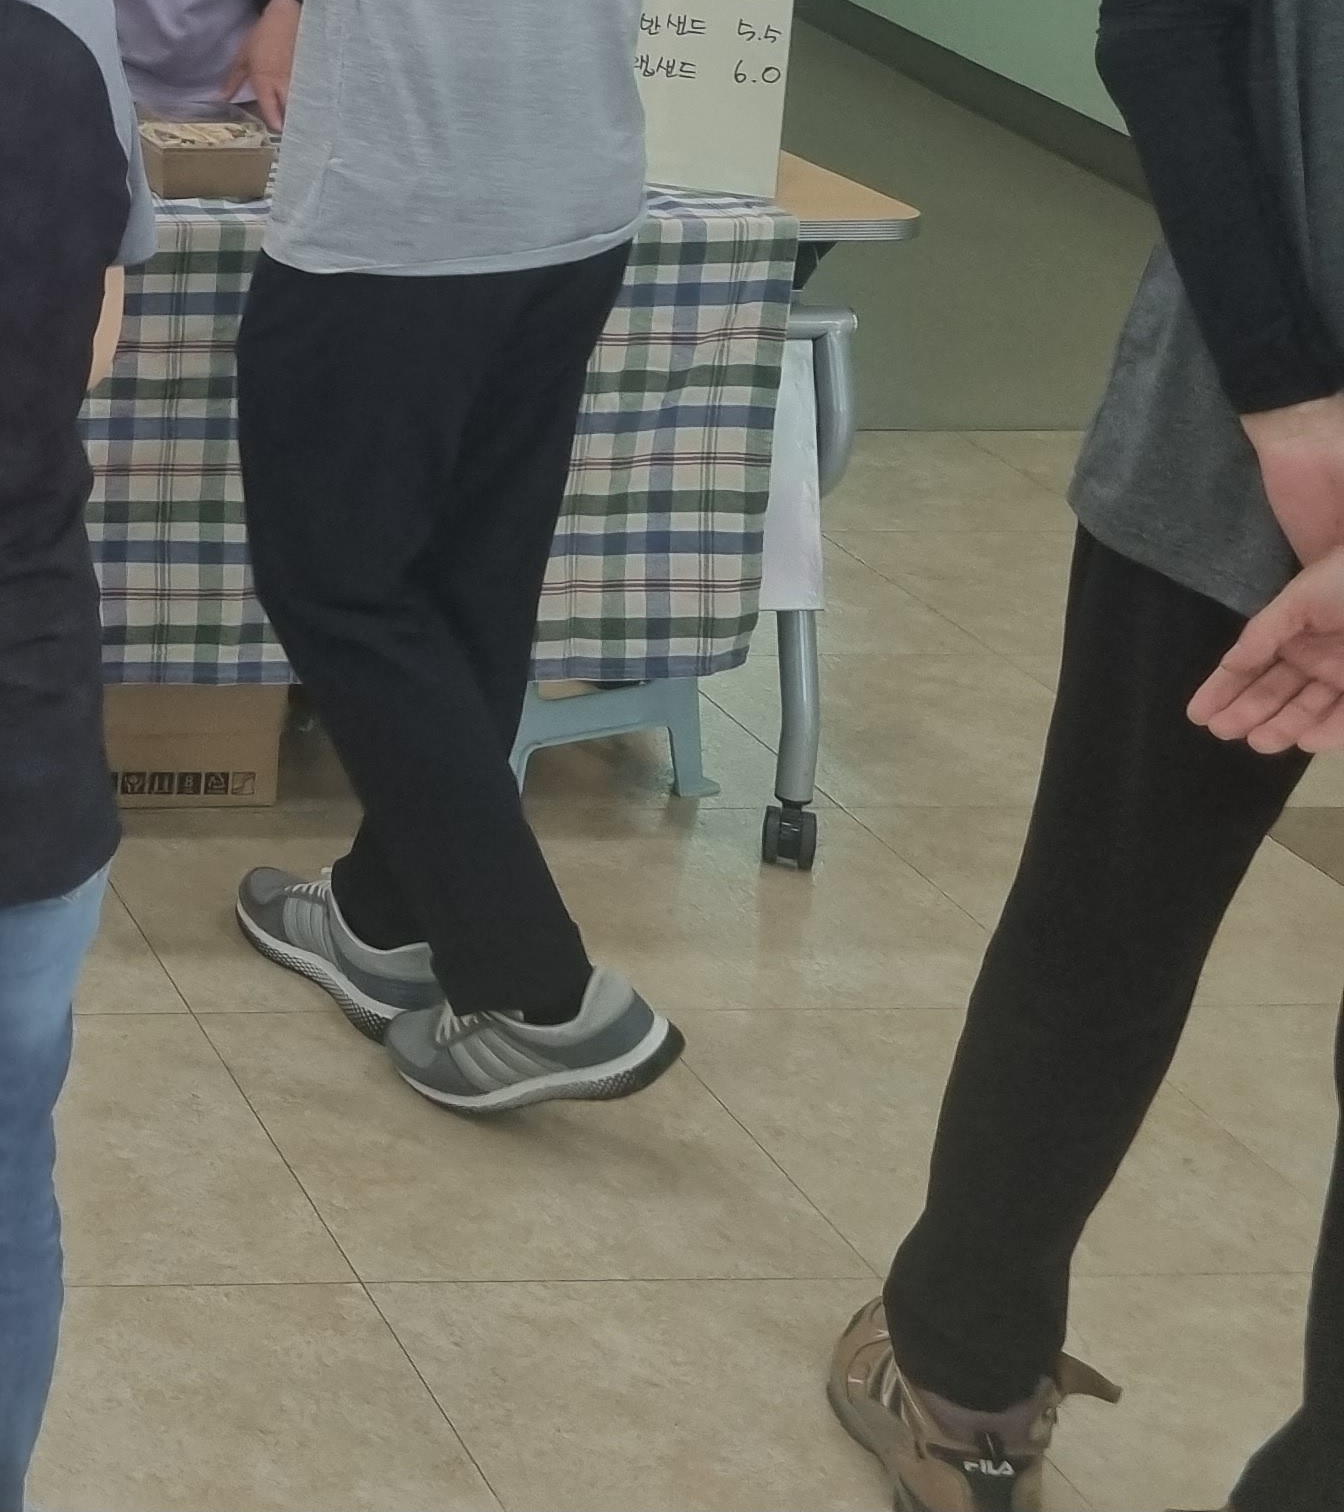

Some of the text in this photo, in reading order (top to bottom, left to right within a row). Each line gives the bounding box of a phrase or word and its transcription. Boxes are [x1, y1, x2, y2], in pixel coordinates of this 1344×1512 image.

[737, 18, 782, 43] 5.5
[734, 59, 781, 84] 6.0
[962, 1459, 1016, 1476] FILA
